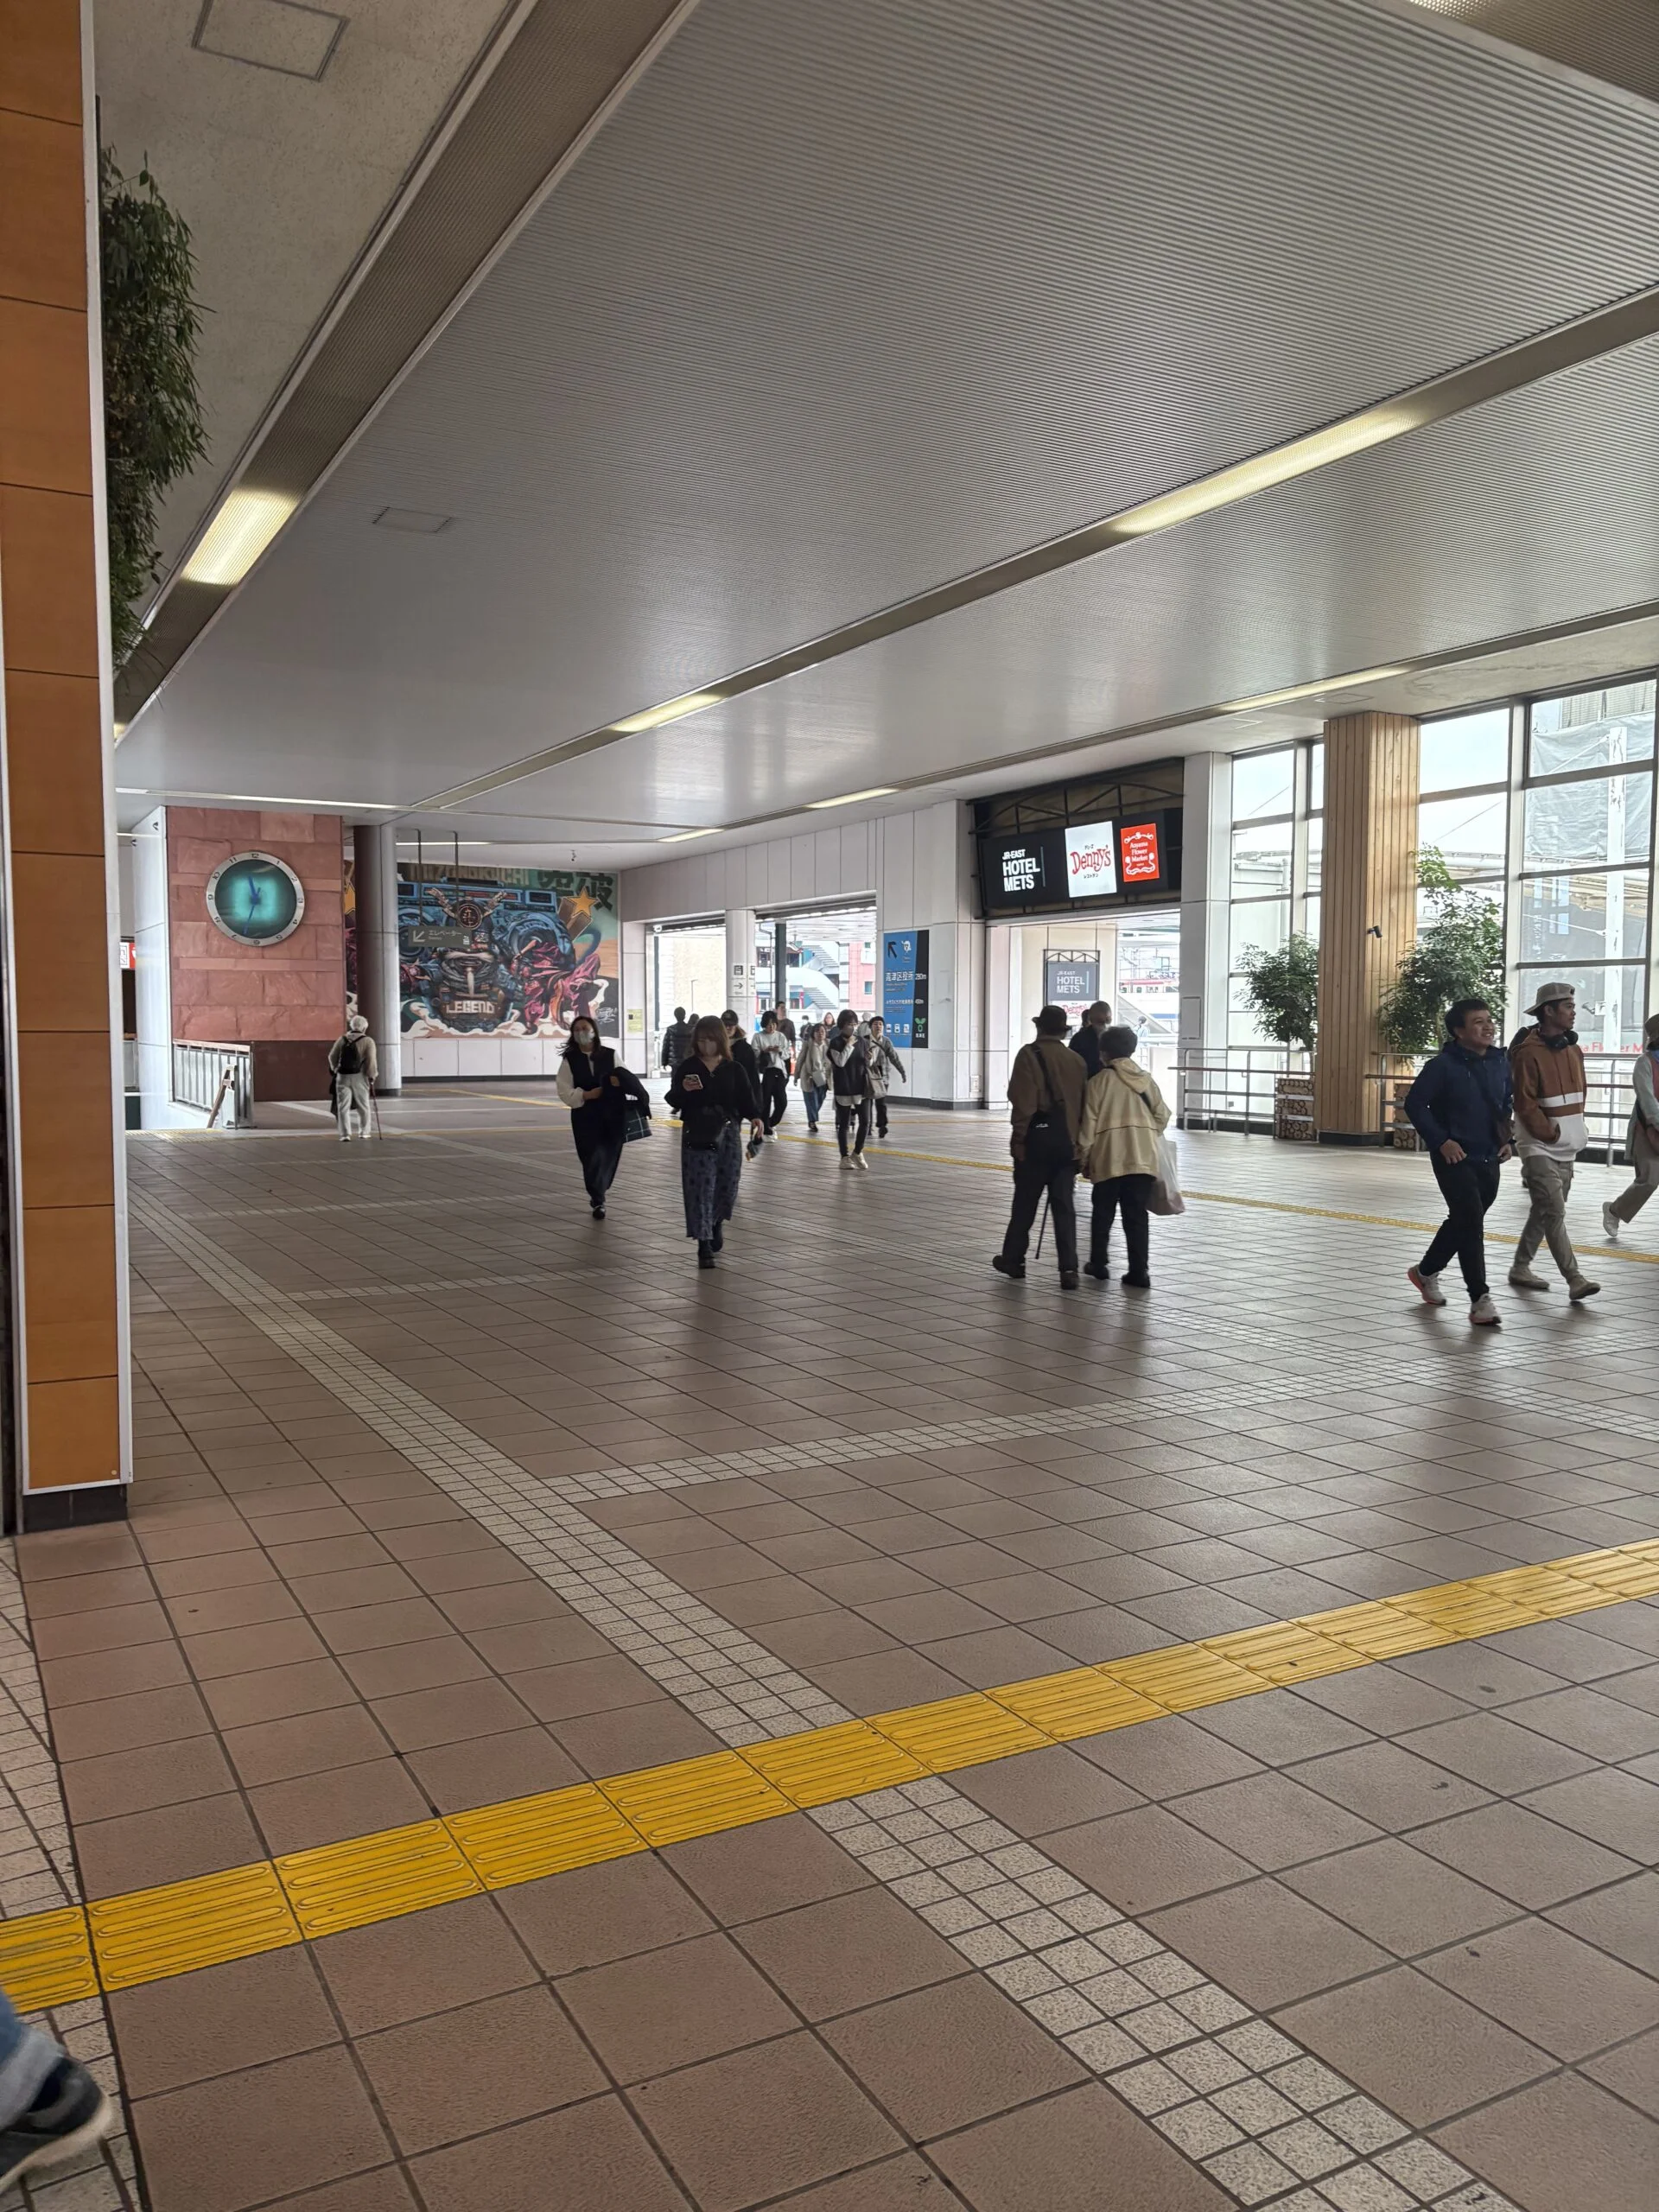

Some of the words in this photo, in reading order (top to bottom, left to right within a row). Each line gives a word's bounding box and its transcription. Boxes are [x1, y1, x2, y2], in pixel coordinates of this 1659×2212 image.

[1001, 849, 1026, 860] JR-EAST
[1070, 843, 1111, 875] Denny's
[1002, 857, 1040, 876] HOTEL
[1003, 874, 1035, 892] METS
[1056, 976, 1085, 985] HOTEL
[1056, 985, 1080, 994] METS
[446, 1000, 495, 1014] LEGEND
